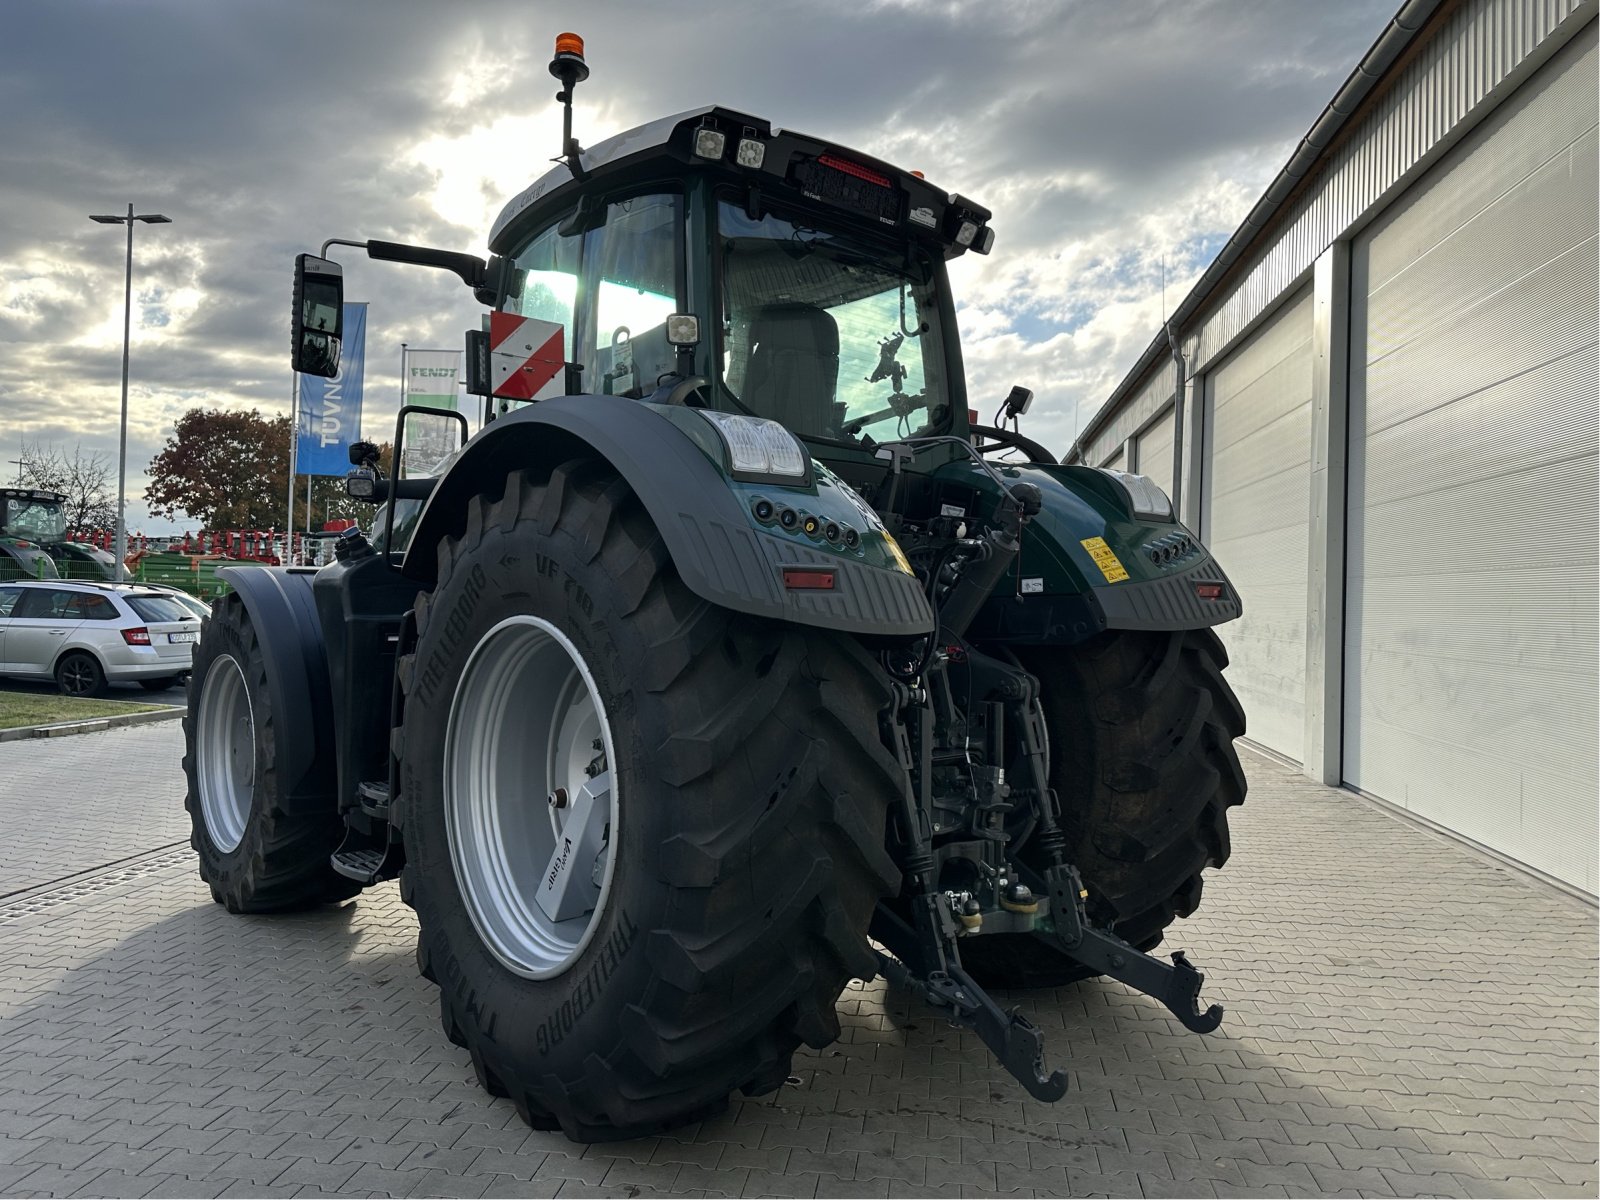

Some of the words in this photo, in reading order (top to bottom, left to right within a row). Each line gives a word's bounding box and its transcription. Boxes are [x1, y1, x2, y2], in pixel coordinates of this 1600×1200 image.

[320, 360, 343, 449] TÜVNO
[411, 367, 458, 378] FENDT
[536, 553, 560, 577] VF
[416, 563, 487, 709] TRELLEBORG
[535, 911, 639, 1056] TRELLEBORG
